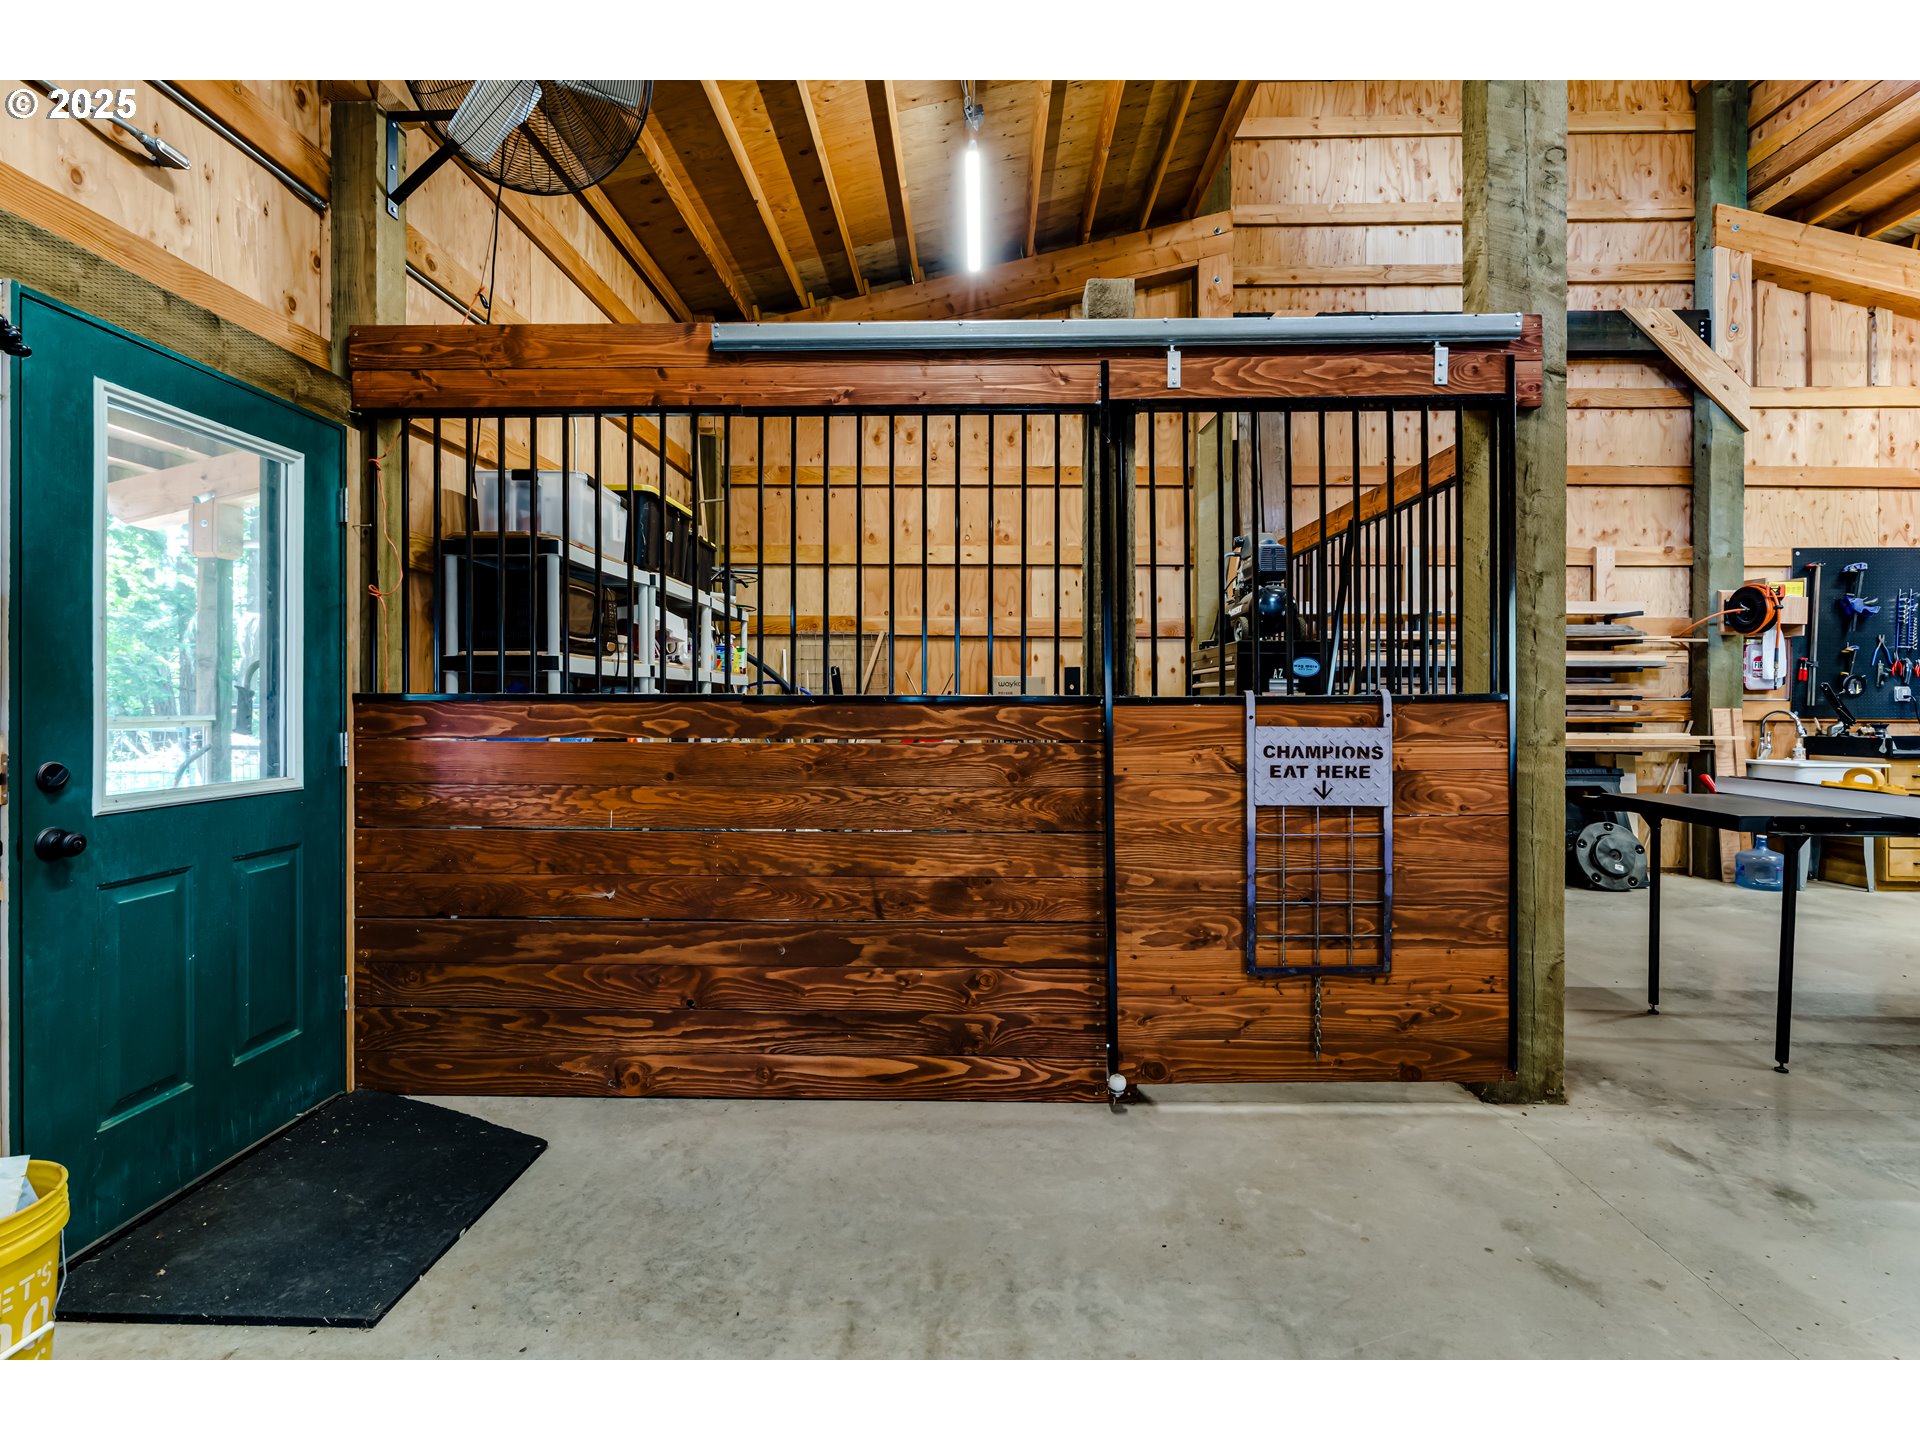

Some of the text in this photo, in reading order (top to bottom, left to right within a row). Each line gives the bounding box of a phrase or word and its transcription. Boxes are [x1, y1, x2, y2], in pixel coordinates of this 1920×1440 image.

[1263, 745, 1384, 760] CHAMPIONS
[1269, 765, 1371, 779] EAT HERE
